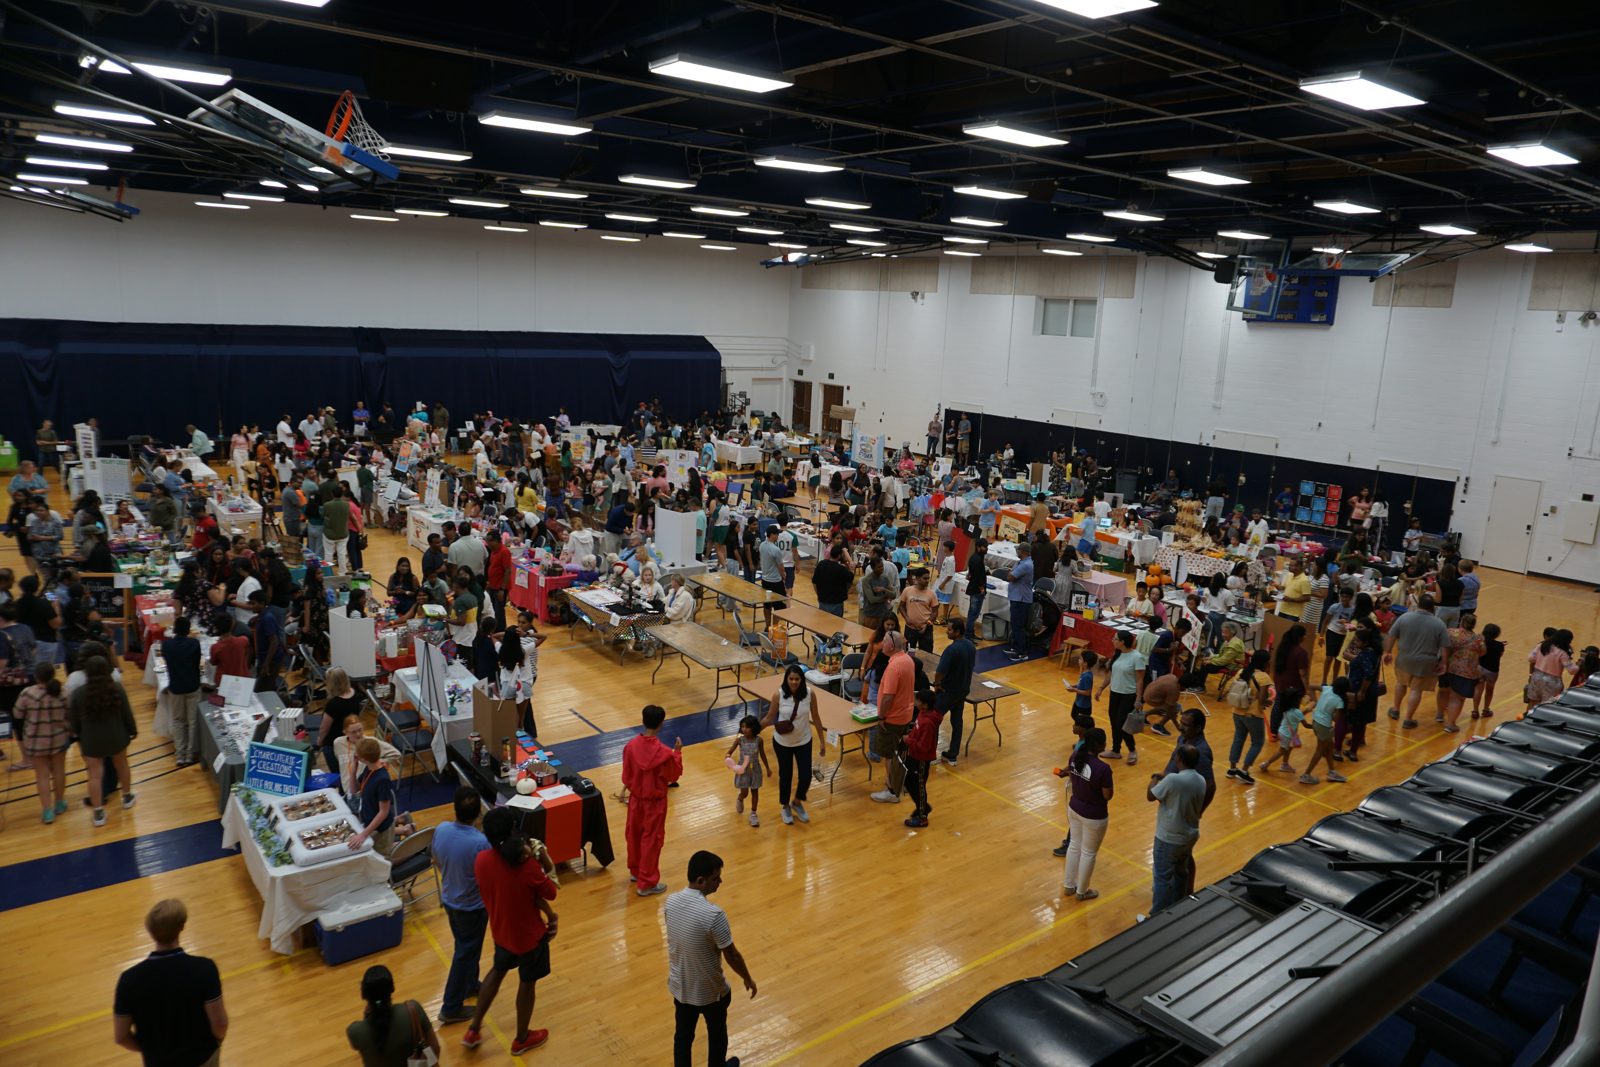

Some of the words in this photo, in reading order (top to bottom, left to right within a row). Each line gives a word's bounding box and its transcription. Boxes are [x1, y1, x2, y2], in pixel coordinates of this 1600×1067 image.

[775, 540, 790, 551] 01
[253, 749, 296, 765] CHARCUTERIE
[257, 760, 292, 775] CREATIONS
